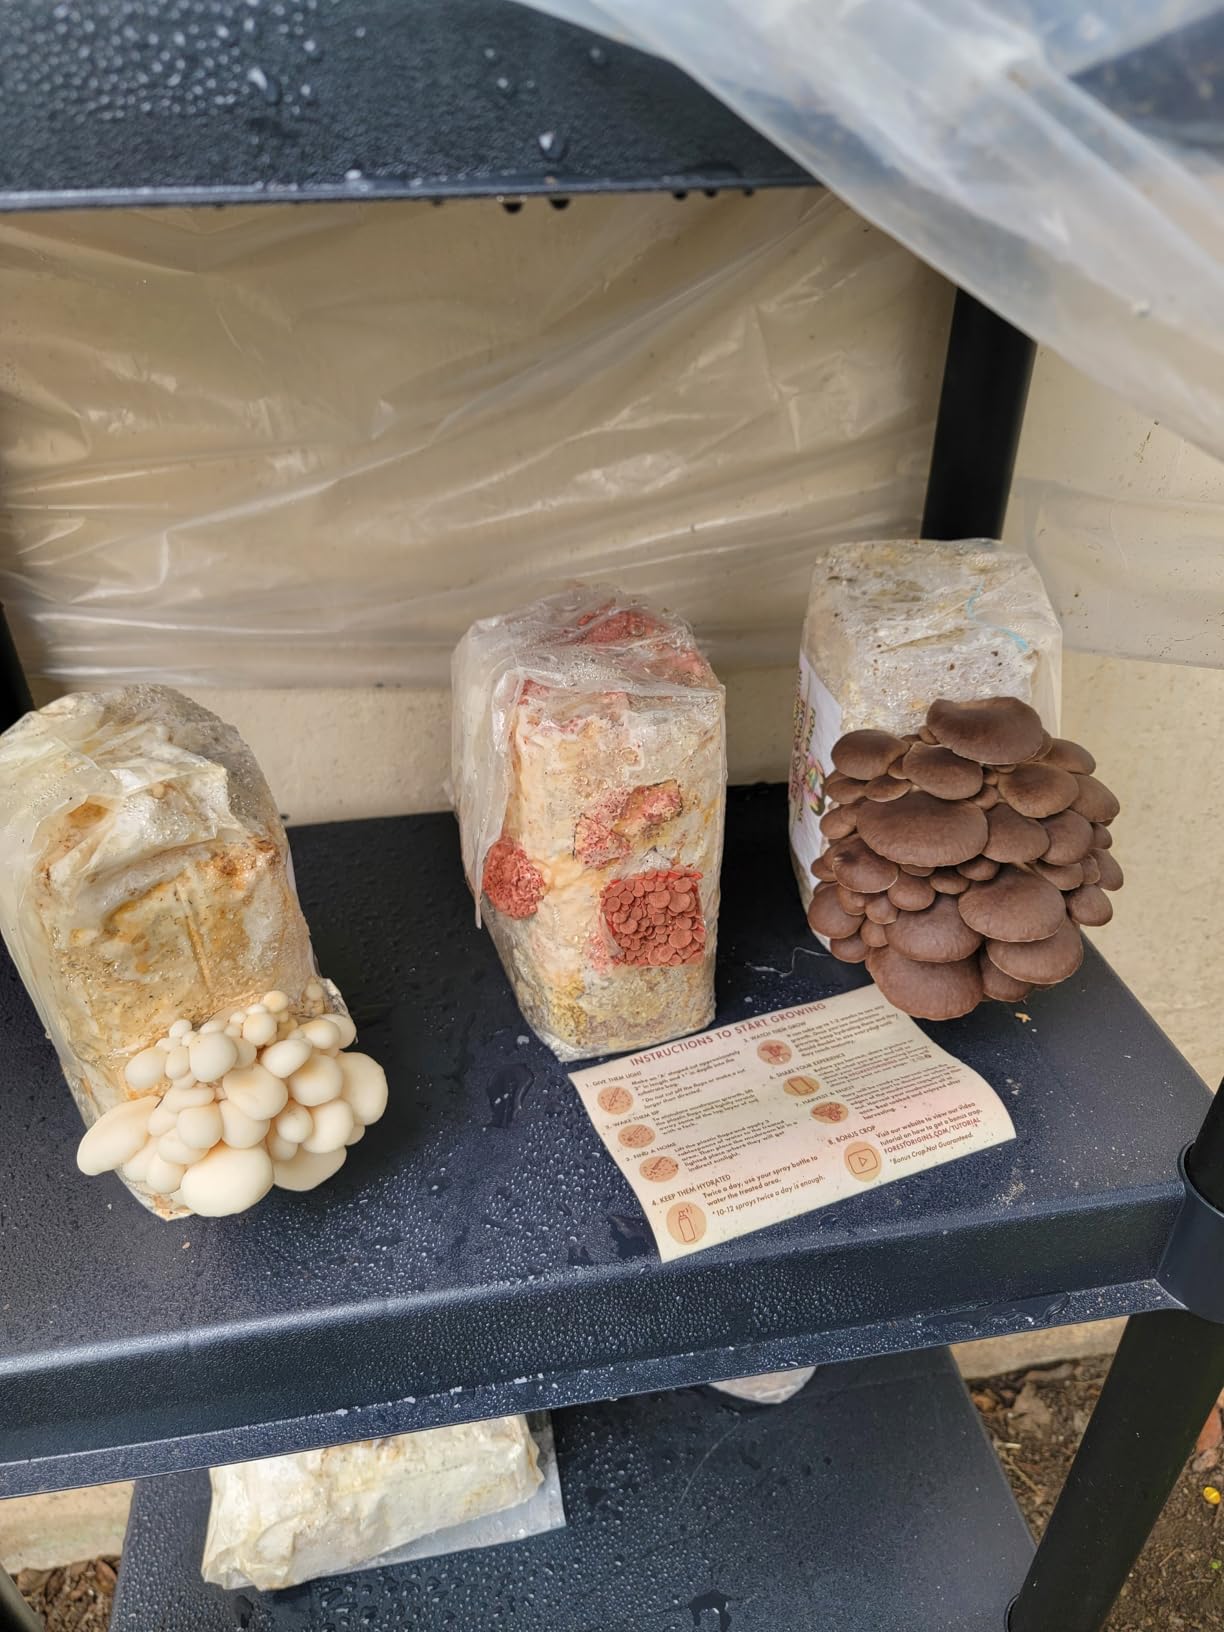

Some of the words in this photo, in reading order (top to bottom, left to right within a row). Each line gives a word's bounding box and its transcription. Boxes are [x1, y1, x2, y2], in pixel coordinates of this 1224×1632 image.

[630, 1037, 713, 1066] INSTRUCTIONS
[716, 1030, 733, 1041] TO
[735, 1020, 768, 1035] START
[770, 1003, 827, 1024] GROWING
[593, 1079, 607, 1087] GIVE
[609, 1075, 624, 1083] THEM
[835, 1131, 859, 1143] BONUS
[859, 1124, 876, 1135] CROP
[876, 1130, 890, 1139] Visit
[901, 1118, 925, 1130] website
[932, 1110, 948, 1120] view
[880, 1134, 903, 1146] tutorial
[912, 1127, 926, 1135] how
[933, 1120, 945, 1130] get
[948, 1113, 967, 1123] bonus
[968, 1109, 984, 1118] crop.
[659, 1192, 677, 1204] KEEP
[677, 1185, 696, 1197] THEM
[697, 1174, 731, 1190] HYDRATED
[702, 1187, 722, 1199] Twice
[728, 1180, 745, 1192] day,
[745, 1177, 756, 1185] use
[757, 1172, 773, 1182] your
[773, 1165, 792, 1176] spray
[791, 1157, 811, 1168] bottle
[706, 1195, 727, 1207] water
[727, 1191, 738, 1199] the
[738, 1183, 763, 1195] treated
[764, 1177, 782, 1187] area.
[736, 1200, 757, 1212] sprays
[756, 1191, 774, 1202] twice
[780, 1184, 795, 1196] day
[799, 1174, 826, 1189] enough.
